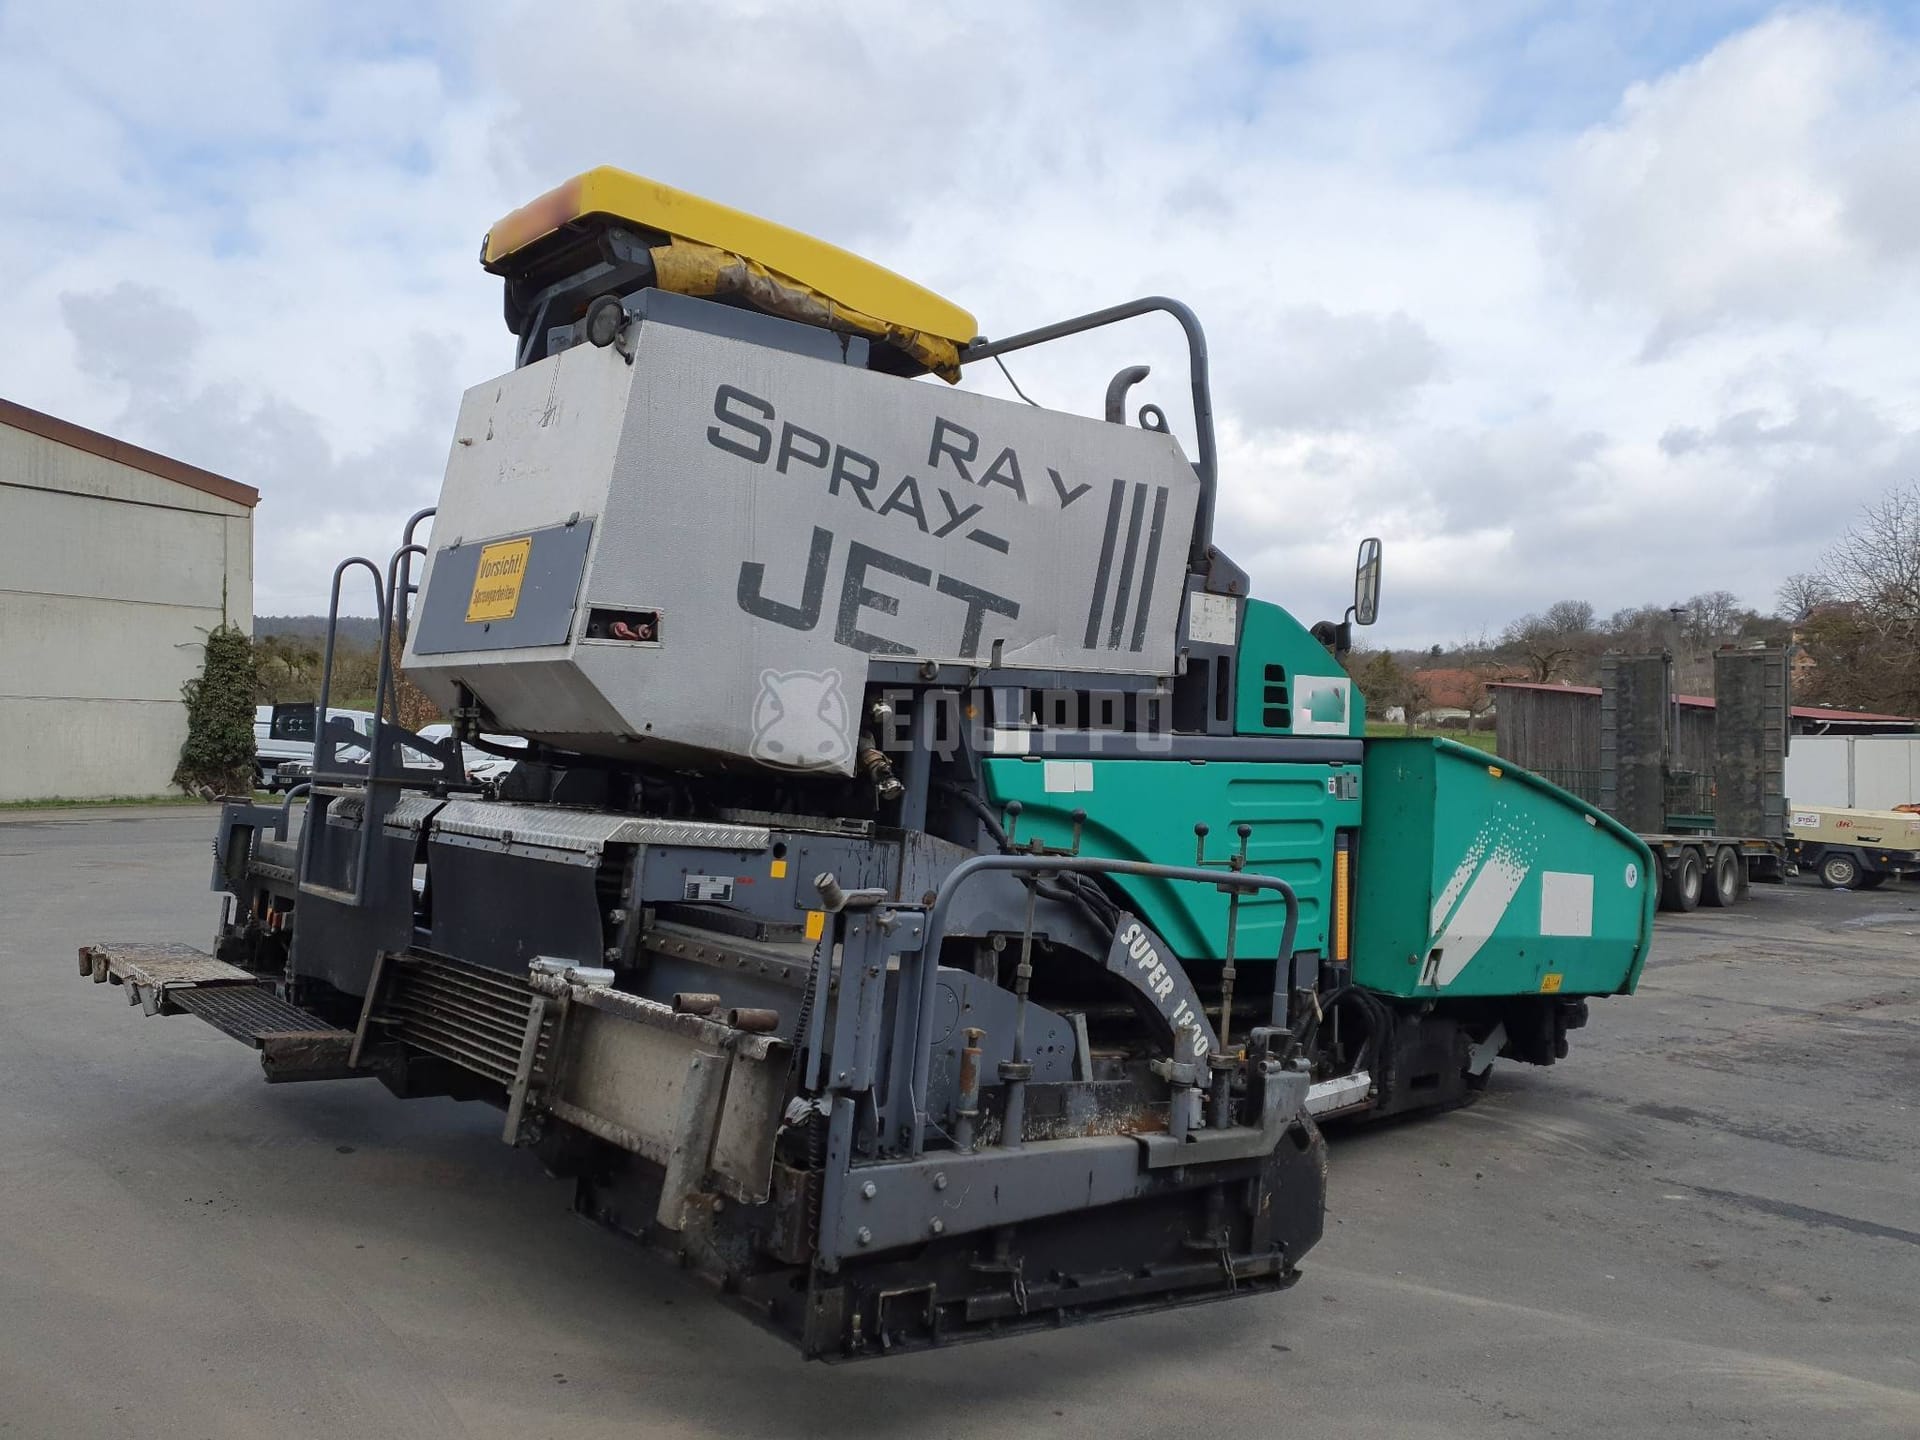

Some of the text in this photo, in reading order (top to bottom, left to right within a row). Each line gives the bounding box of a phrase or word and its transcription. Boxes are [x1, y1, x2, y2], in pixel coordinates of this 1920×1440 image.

[480, 553, 523, 579] Vorsicht!
[737, 525, 1021, 658] JET
[1120, 923, 1175, 1003] SUPER
